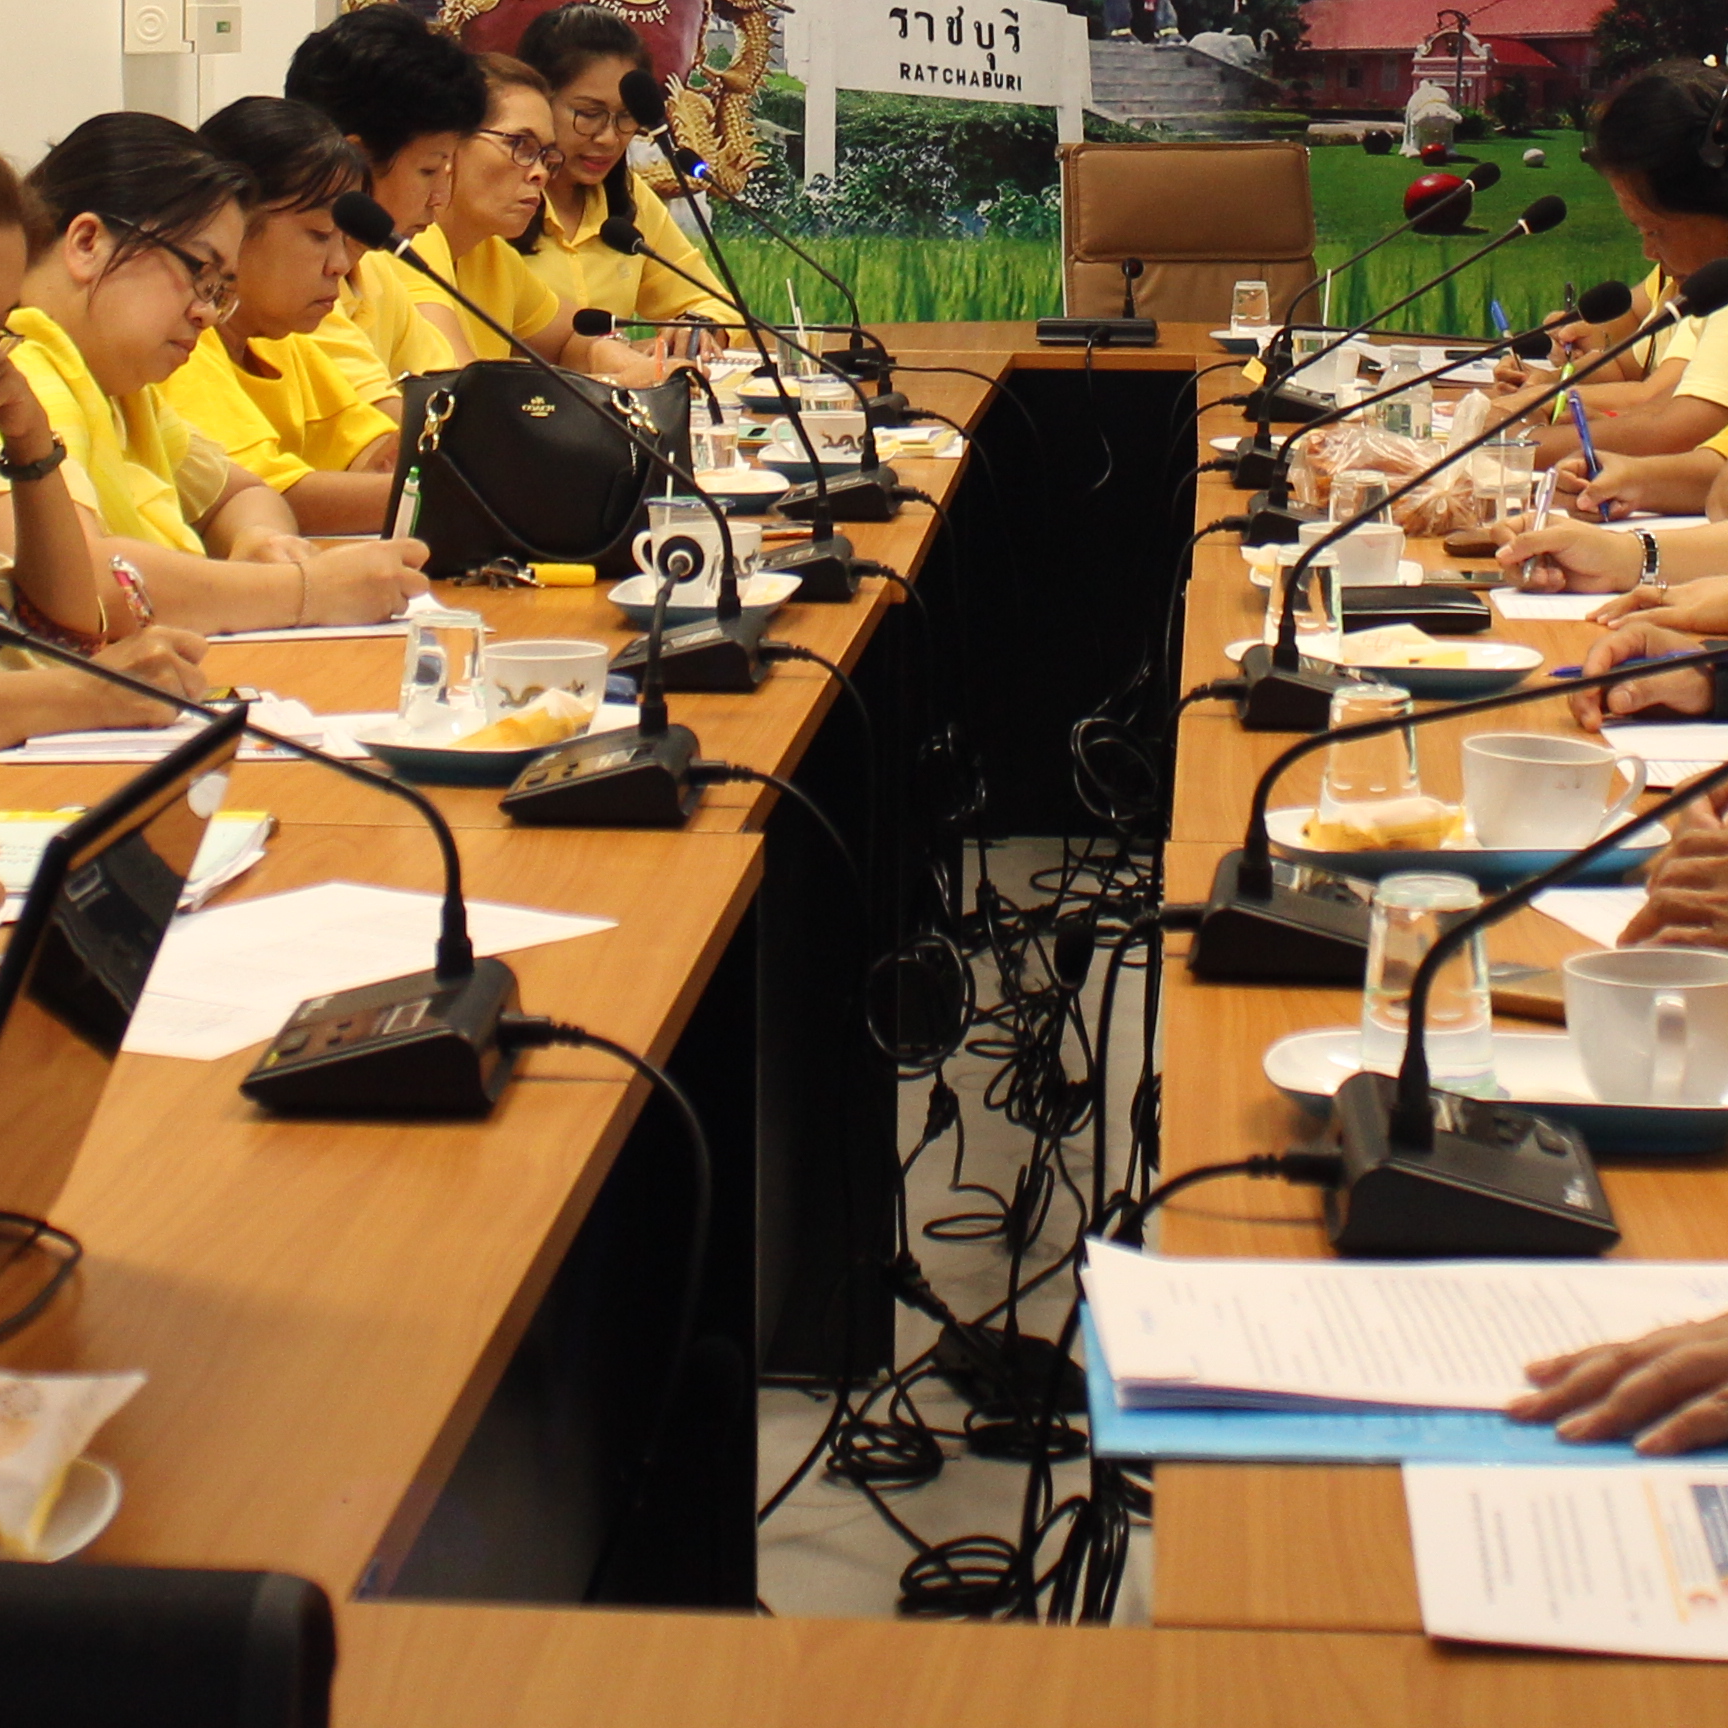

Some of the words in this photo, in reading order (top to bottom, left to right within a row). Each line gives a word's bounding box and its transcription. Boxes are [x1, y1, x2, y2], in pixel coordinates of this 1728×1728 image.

[888, 5, 1021, 72] ราชบุรี
[899, 62, 1022, 92] RATCHABURI
